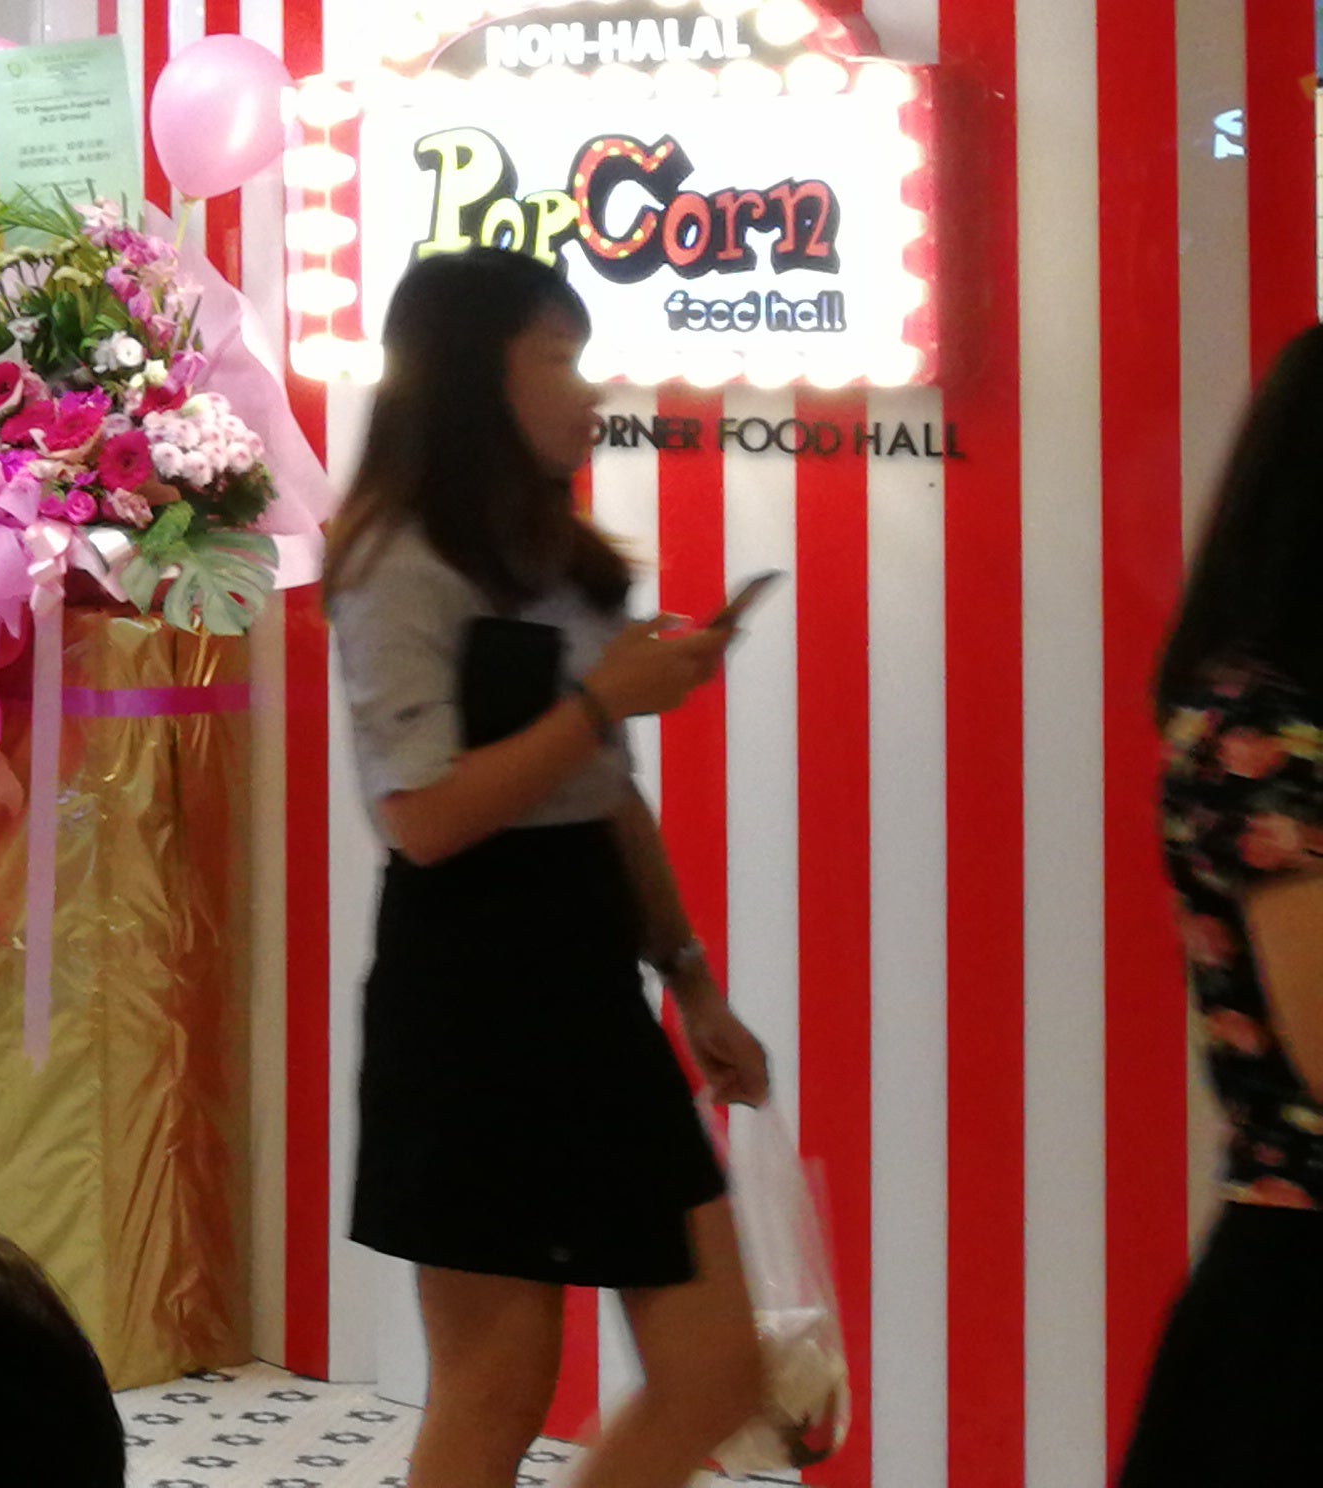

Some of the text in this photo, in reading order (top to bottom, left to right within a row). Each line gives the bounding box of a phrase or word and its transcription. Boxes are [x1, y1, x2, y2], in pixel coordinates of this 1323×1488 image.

[485, 16, 751, 68] NON-HALAL
[664, 290, 847, 333] food hall
[590, 413, 965, 460] ORNER FOOD HALL
